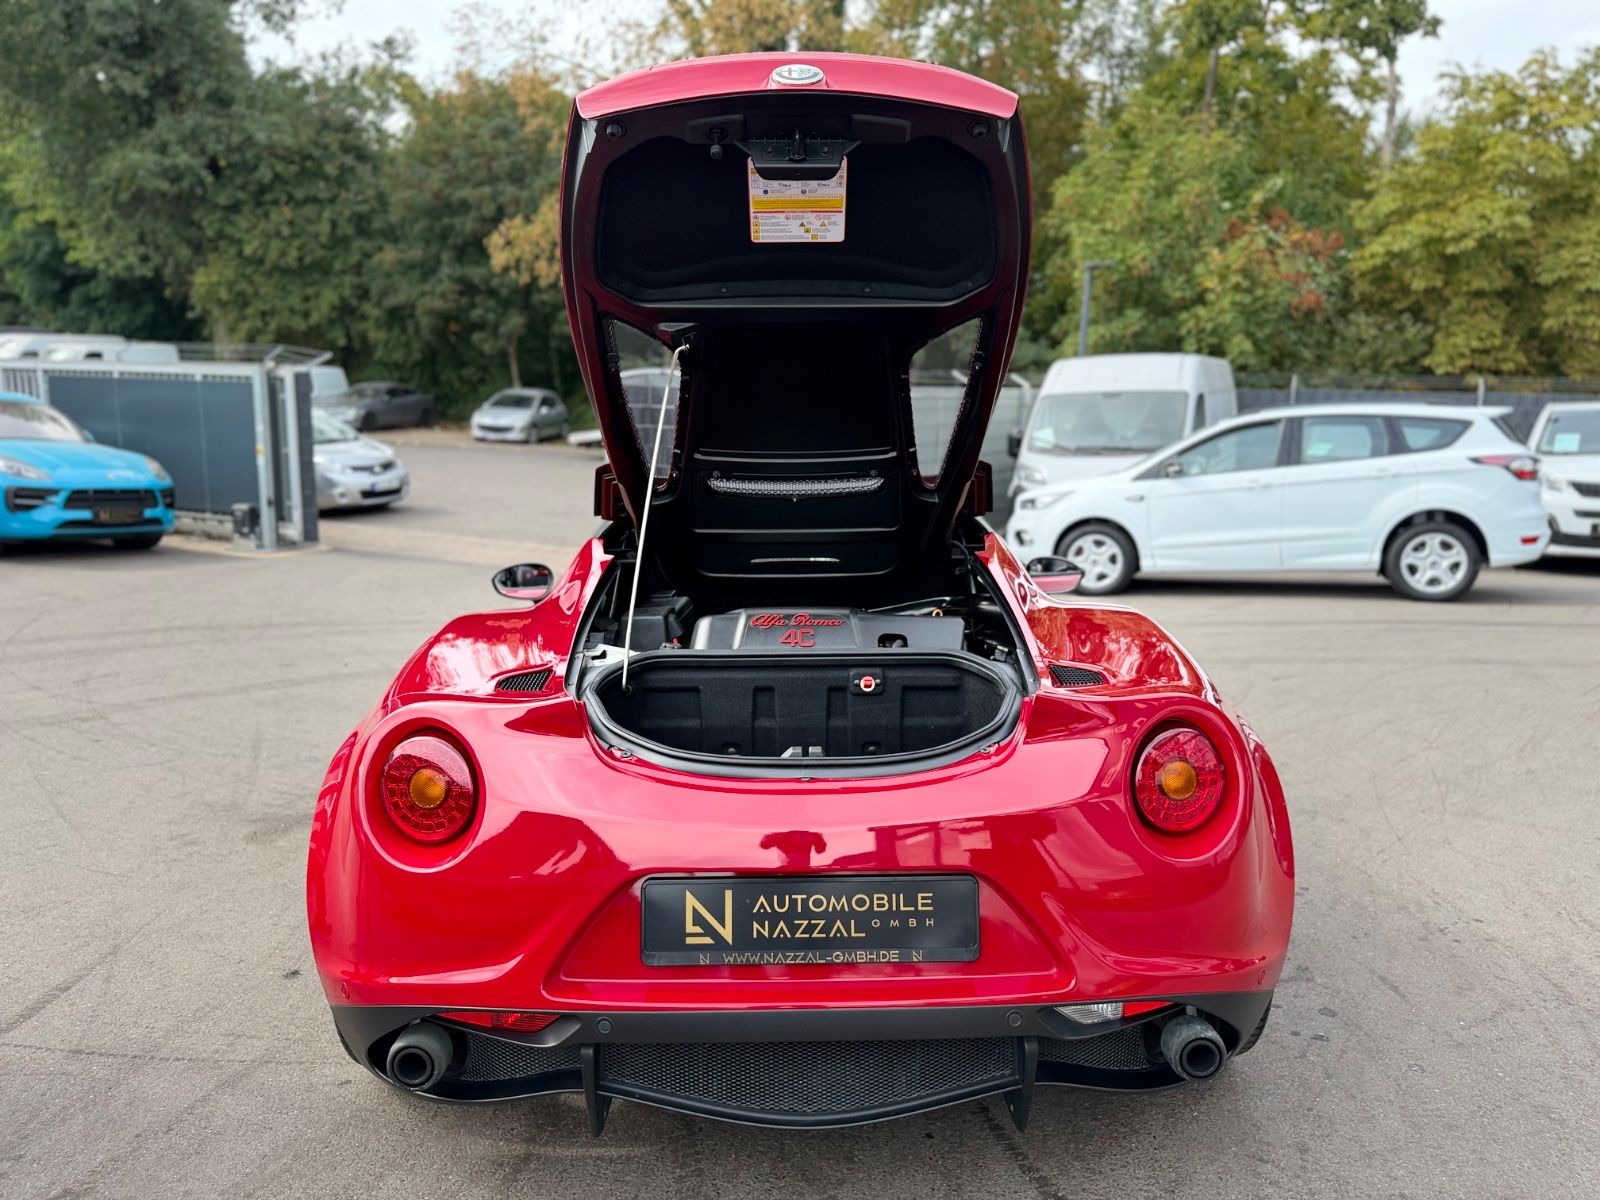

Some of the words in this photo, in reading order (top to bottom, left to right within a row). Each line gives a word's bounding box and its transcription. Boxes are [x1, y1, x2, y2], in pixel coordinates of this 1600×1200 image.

[751, 614, 788, 628] Alfa
[792, 613, 843, 626] Romeo
[779, 629, 815, 647] 4C
[752, 893, 934, 913] AUTOMOBILE
[753, 920, 866, 939] NAZZAL
